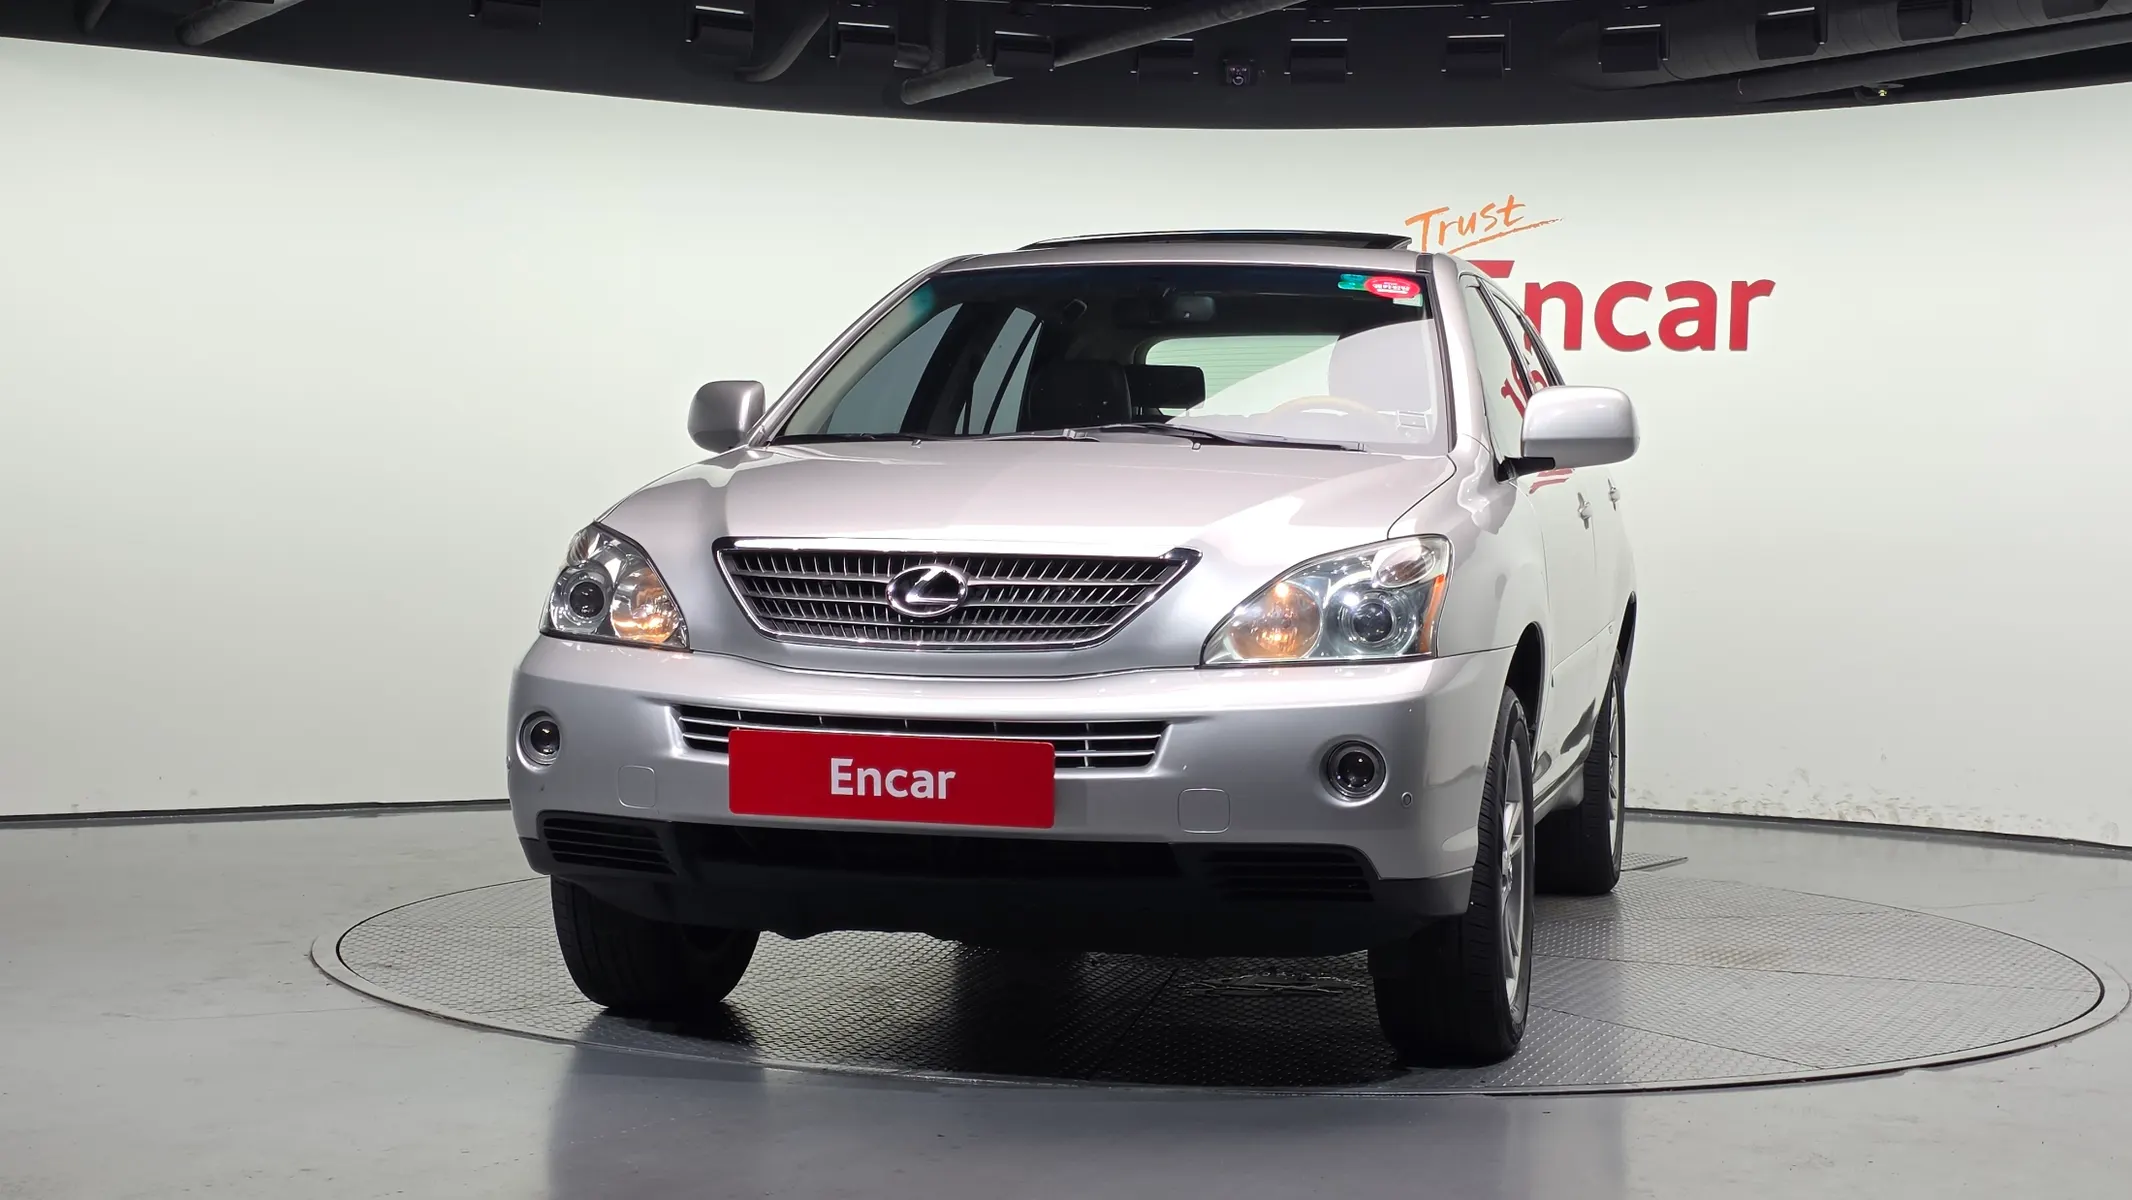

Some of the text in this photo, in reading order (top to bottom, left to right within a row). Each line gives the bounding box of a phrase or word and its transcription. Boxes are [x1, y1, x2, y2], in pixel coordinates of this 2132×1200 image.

[1405, 194, 1526, 253] Trust
[1466, 259, 1776, 352] ncar
[830, 757, 955, 799] Encar
